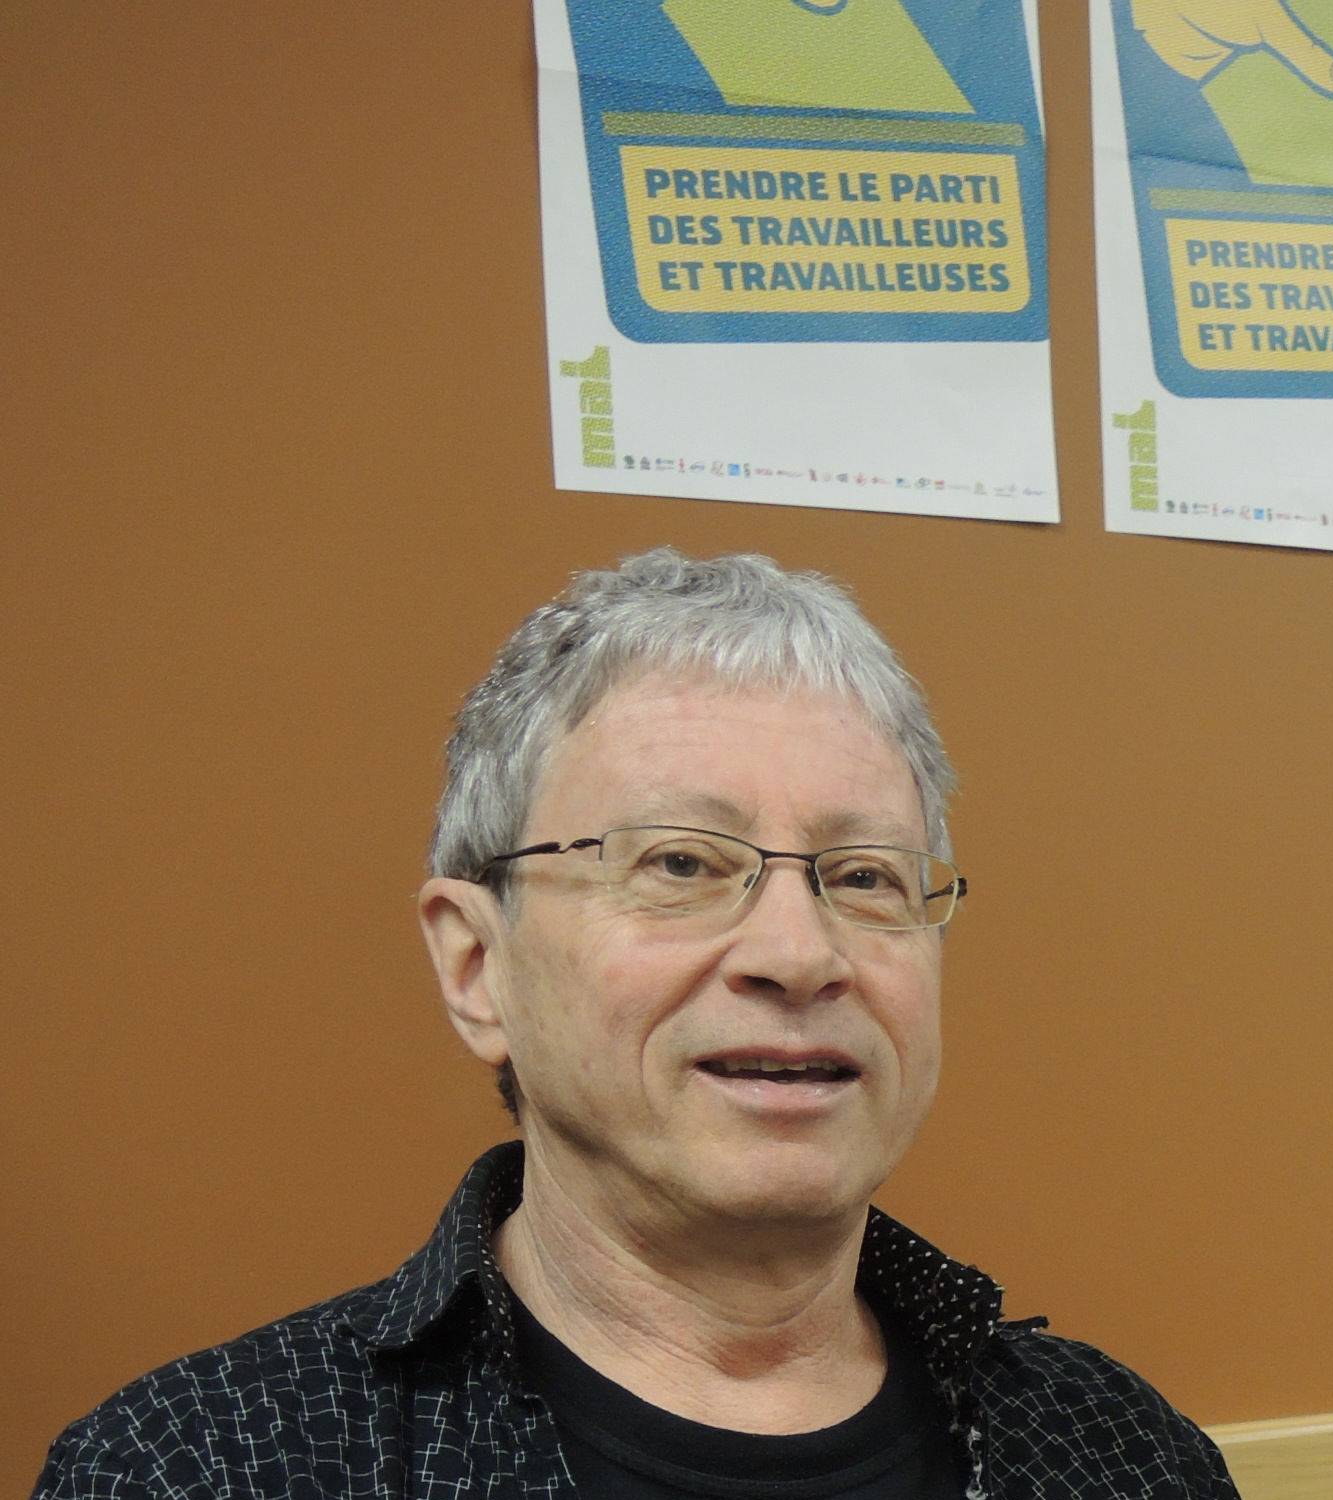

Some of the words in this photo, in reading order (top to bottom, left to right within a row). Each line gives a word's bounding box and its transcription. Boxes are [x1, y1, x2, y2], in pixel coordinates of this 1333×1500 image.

[644, 168, 828, 202] PRENDRE
[839, 172, 881, 202] LE
[890, 174, 1001, 204] PARTI
[647, 214, 722, 245] DES
[732, 216, 1009, 249] TRAVAILLEURS
[659, 261, 704, 291] ET
[715, 261, 1011, 293] TRAVAILLEUSES
[1188, 281, 1252, 310] DES
[1198, 323, 1236, 351] ET
